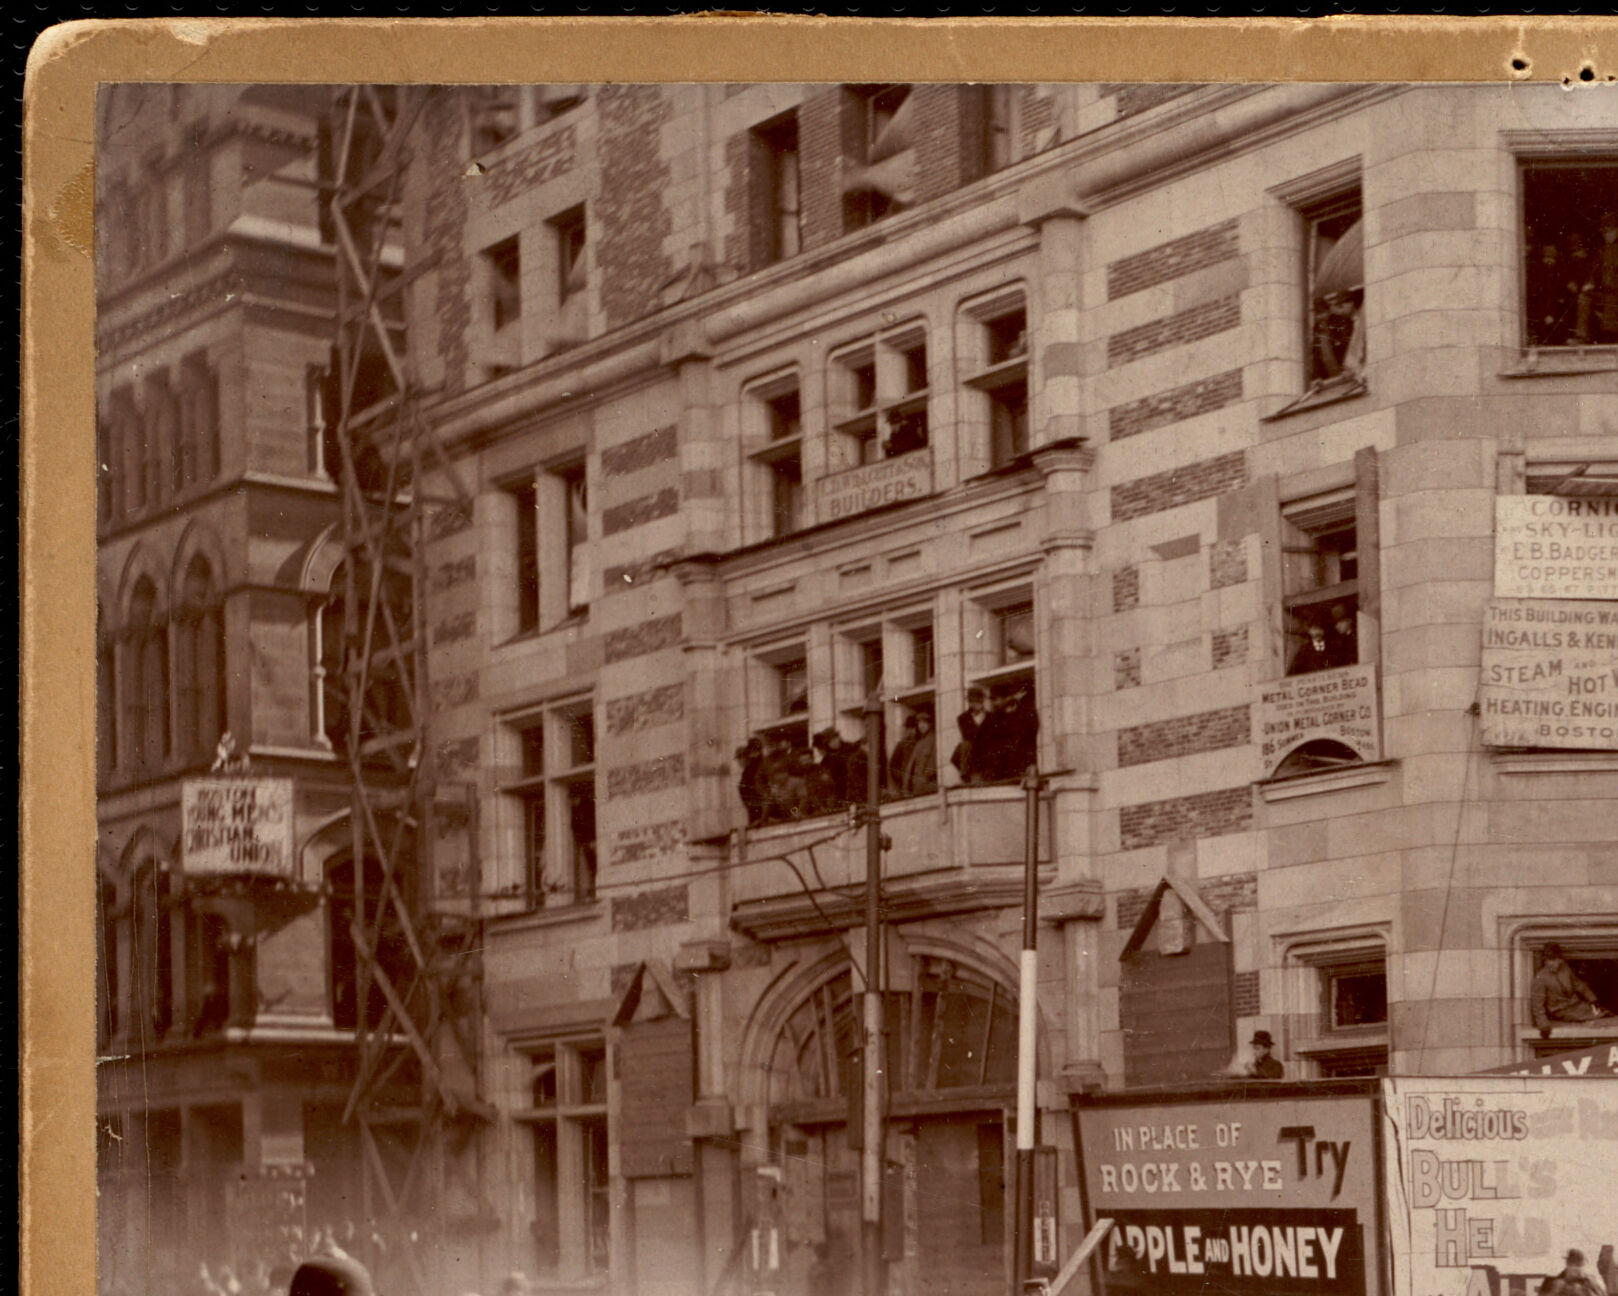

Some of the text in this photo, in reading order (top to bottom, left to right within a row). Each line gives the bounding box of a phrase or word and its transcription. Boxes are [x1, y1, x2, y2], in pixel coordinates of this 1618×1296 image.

[1488, 605, 1523, 623] THIS
[1525, 607, 1595, 625] BUILDING
[1487, 628, 1562, 648] INGALLS
[1566, 632, 1580, 648] &
[1262, 692, 1294, 704] METAL
[1297, 682, 1339, 699] CORNER
[1341, 676, 1368, 690] BEAD
[1490, 658, 1563, 683] STEAM
[1567, 673, 1608, 696] HOT
[1263, 721, 1290, 735] UNION
[1293, 716, 1321, 730] METAL
[1322, 709, 1357, 726] CORNER
[1486, 698, 1565, 717] HEATING
[1406, 1095, 1529, 1141] Delicious
[1113, 1121, 1243, 1151] IN PLACE OF
[1100, 1160, 1284, 1193] ROCK & RYE
[1277, 1125, 1353, 1202] Try
[1410, 1149, 1559, 1209] BULL'S
[1107, 1225, 1206, 1274] APPLE
[1205, 1237, 1230, 1264] AND
[1229, 1225, 1345, 1280] HONEY
